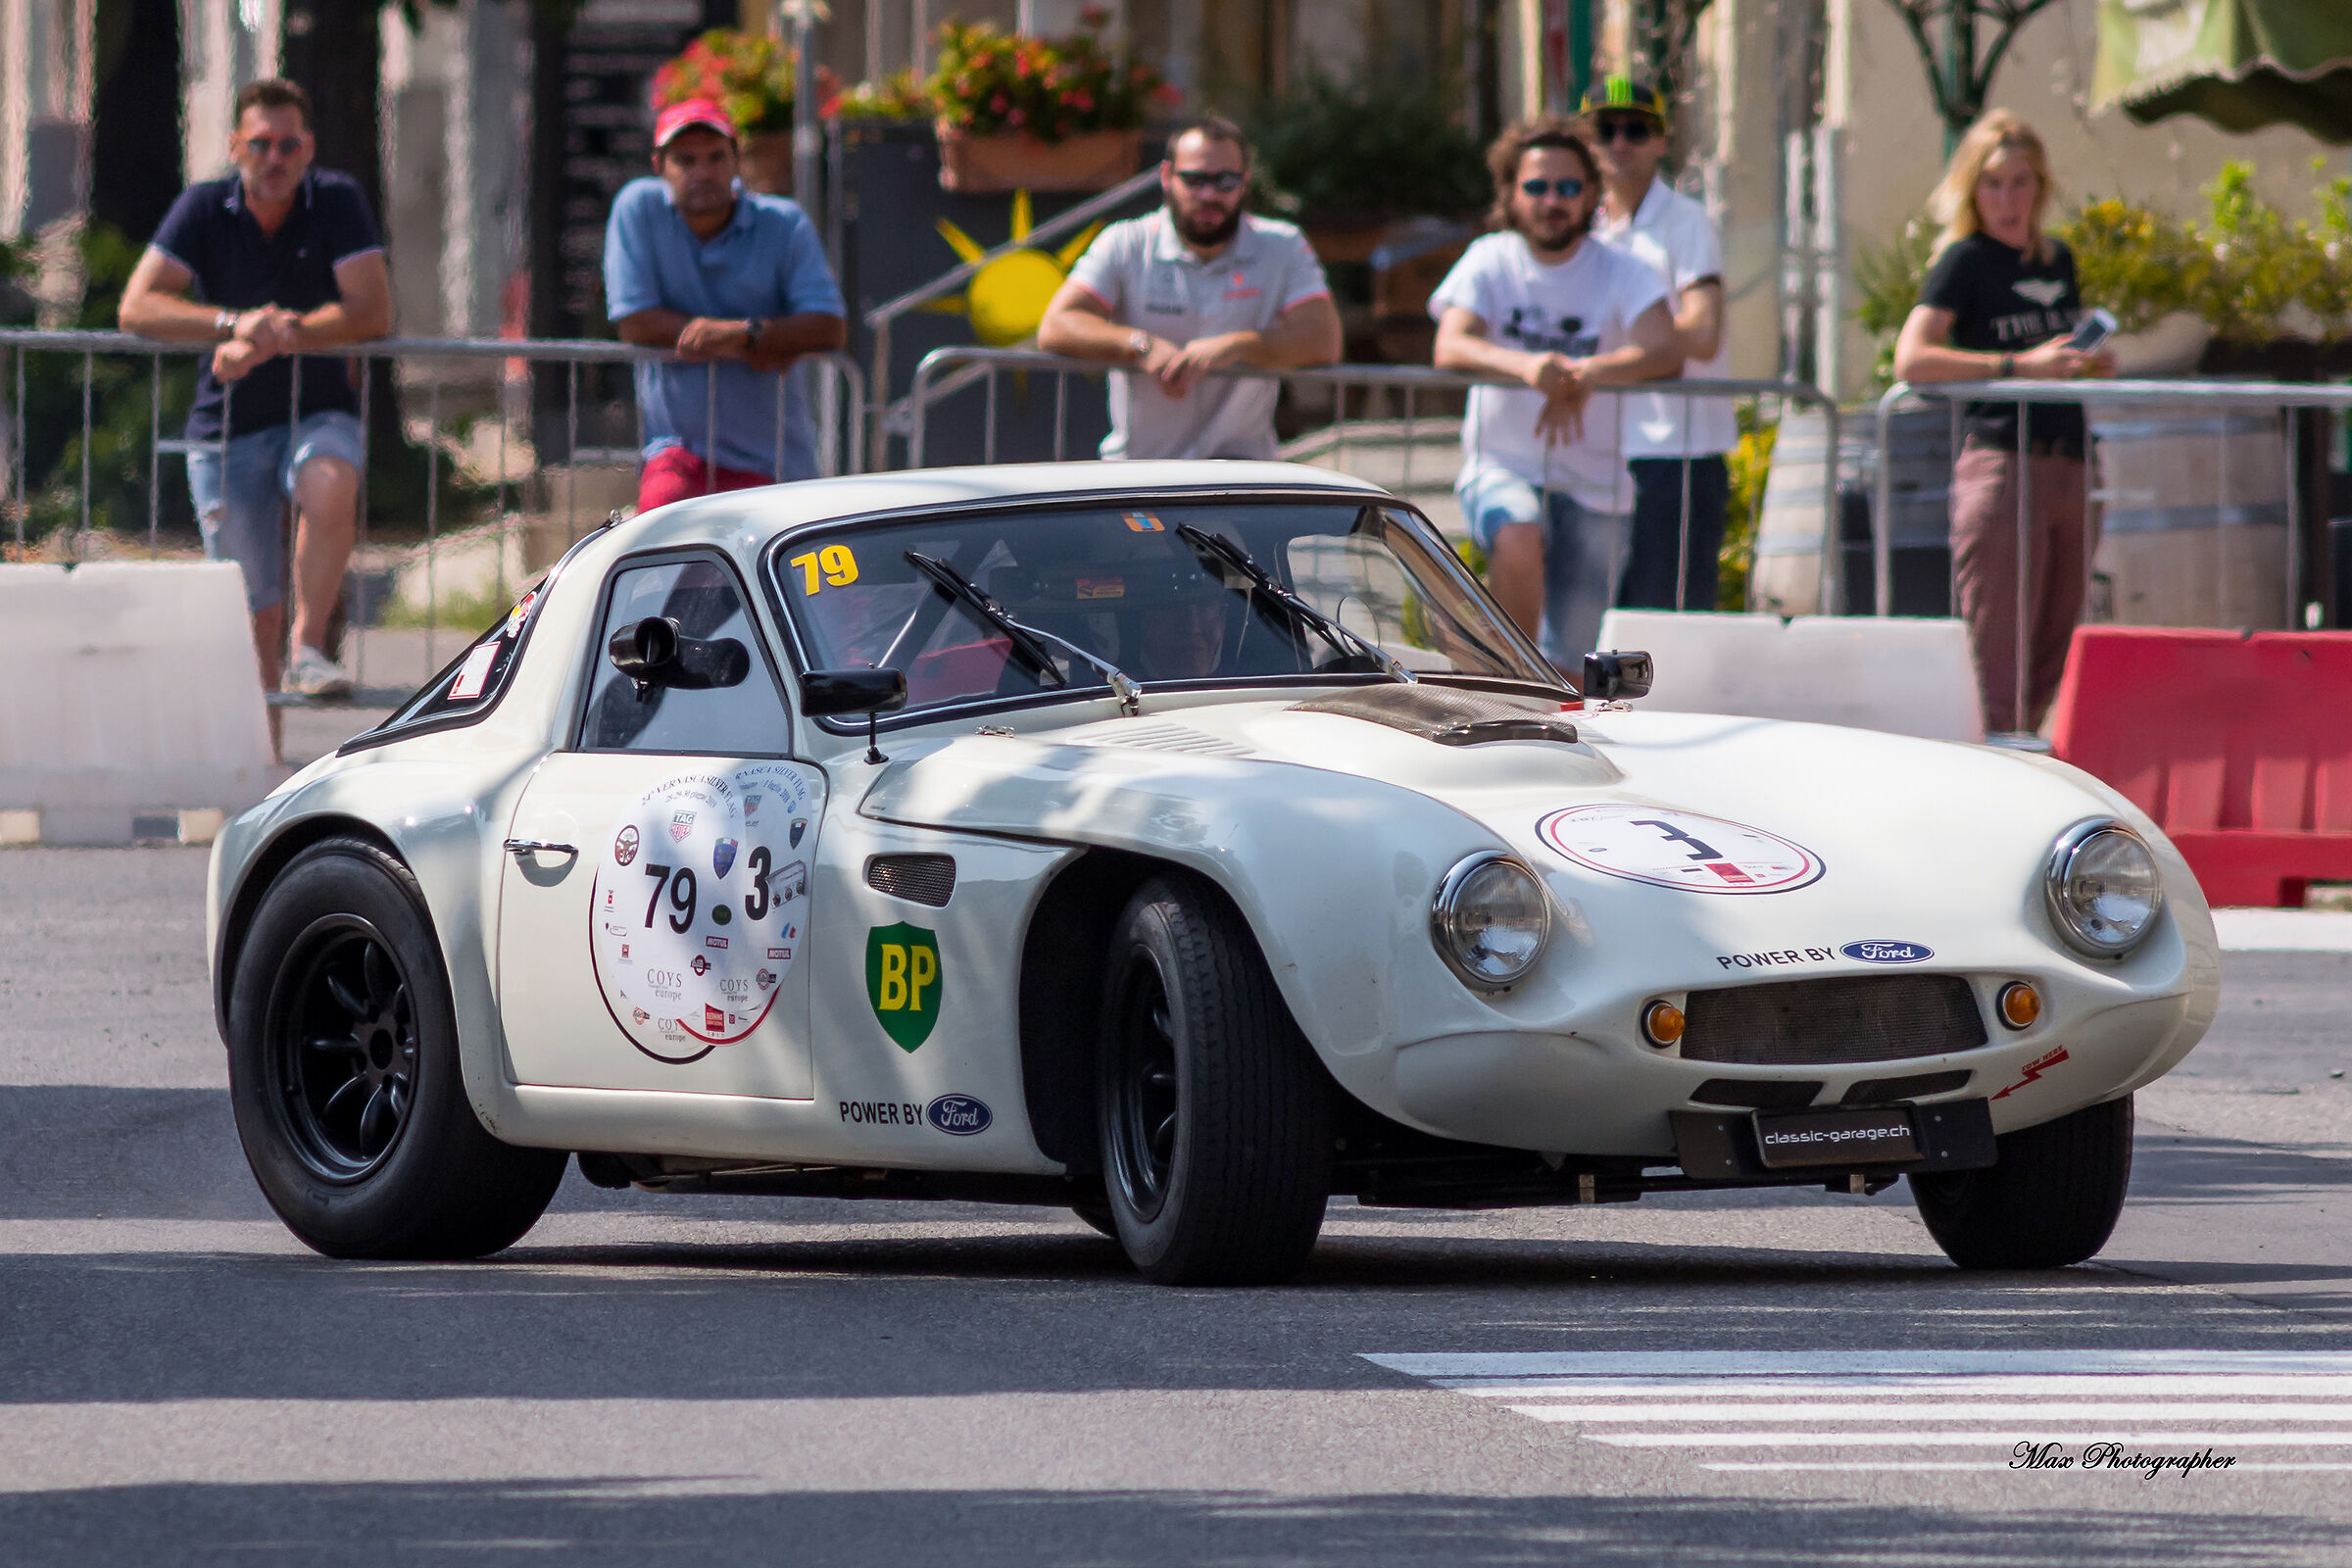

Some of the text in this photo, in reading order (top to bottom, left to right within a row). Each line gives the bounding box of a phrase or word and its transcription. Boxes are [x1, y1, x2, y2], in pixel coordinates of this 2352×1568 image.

[790, 544, 859, 597] 79
[675, 812, 693, 824] TAG
[1629, 819, 1724, 860] 3
[745, 846, 771, 921] 3
[644, 863, 697, 934] 79
[707, 936, 728, 949] MOTUL
[768, 950, 791, 959] MOTUL
[1716, 943, 1916, 970] POWER BY Ford
[647, 968, 682, 988] COYS
[719, 979, 749, 992] COYS
[878, 944, 936, 1011] BP
[655, 989, 682, 1003] europe
[727, 994, 749, 1003] europe
[658, 1017, 680, 1031] COY
[664, 1033, 686, 1043] europe
[2022, 1044, 2063, 1072] TOW HERE
[839, 1100, 979, 1126] POWER BY Ford
[1765, 1124, 1910, 1145] classic-garage.ch
